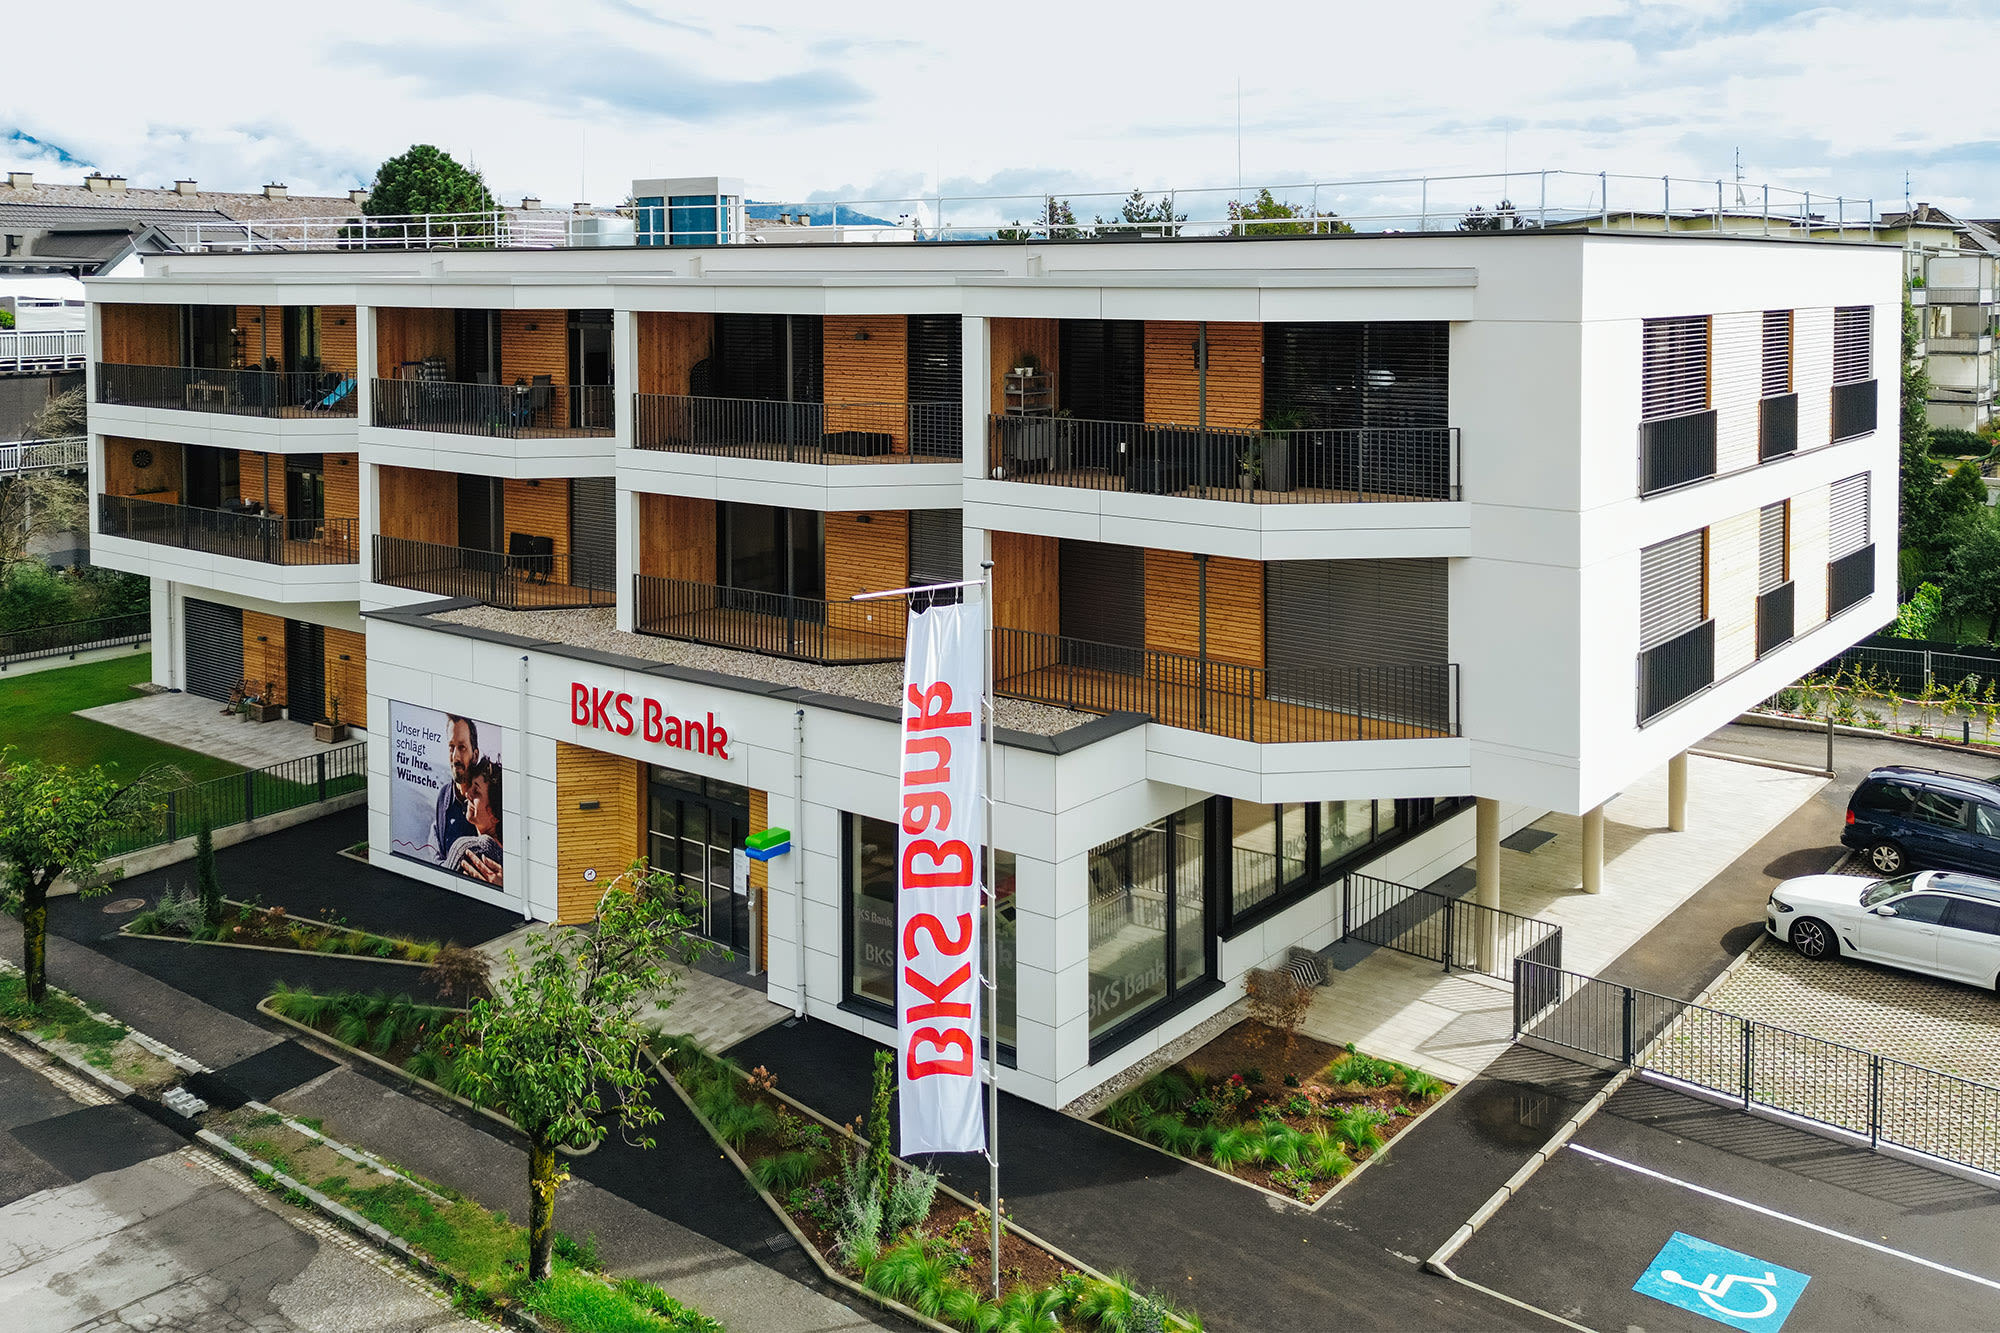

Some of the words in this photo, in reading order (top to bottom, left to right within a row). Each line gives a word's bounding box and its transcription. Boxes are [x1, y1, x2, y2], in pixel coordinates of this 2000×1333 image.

[396, 720, 420, 736] Unser
[422, 727, 441, 743] Herz
[571, 682, 634, 736] BKS
[643, 697, 728, 760] Bank
[396, 738, 426, 756] schlägt
[396, 751, 410, 765] für
[396, 766, 439, 789] Wünsche.
[871, 911, 893, 928] Bank
[864, 943, 894, 967] BKS
[1124, 958, 1166, 1001] Bank
